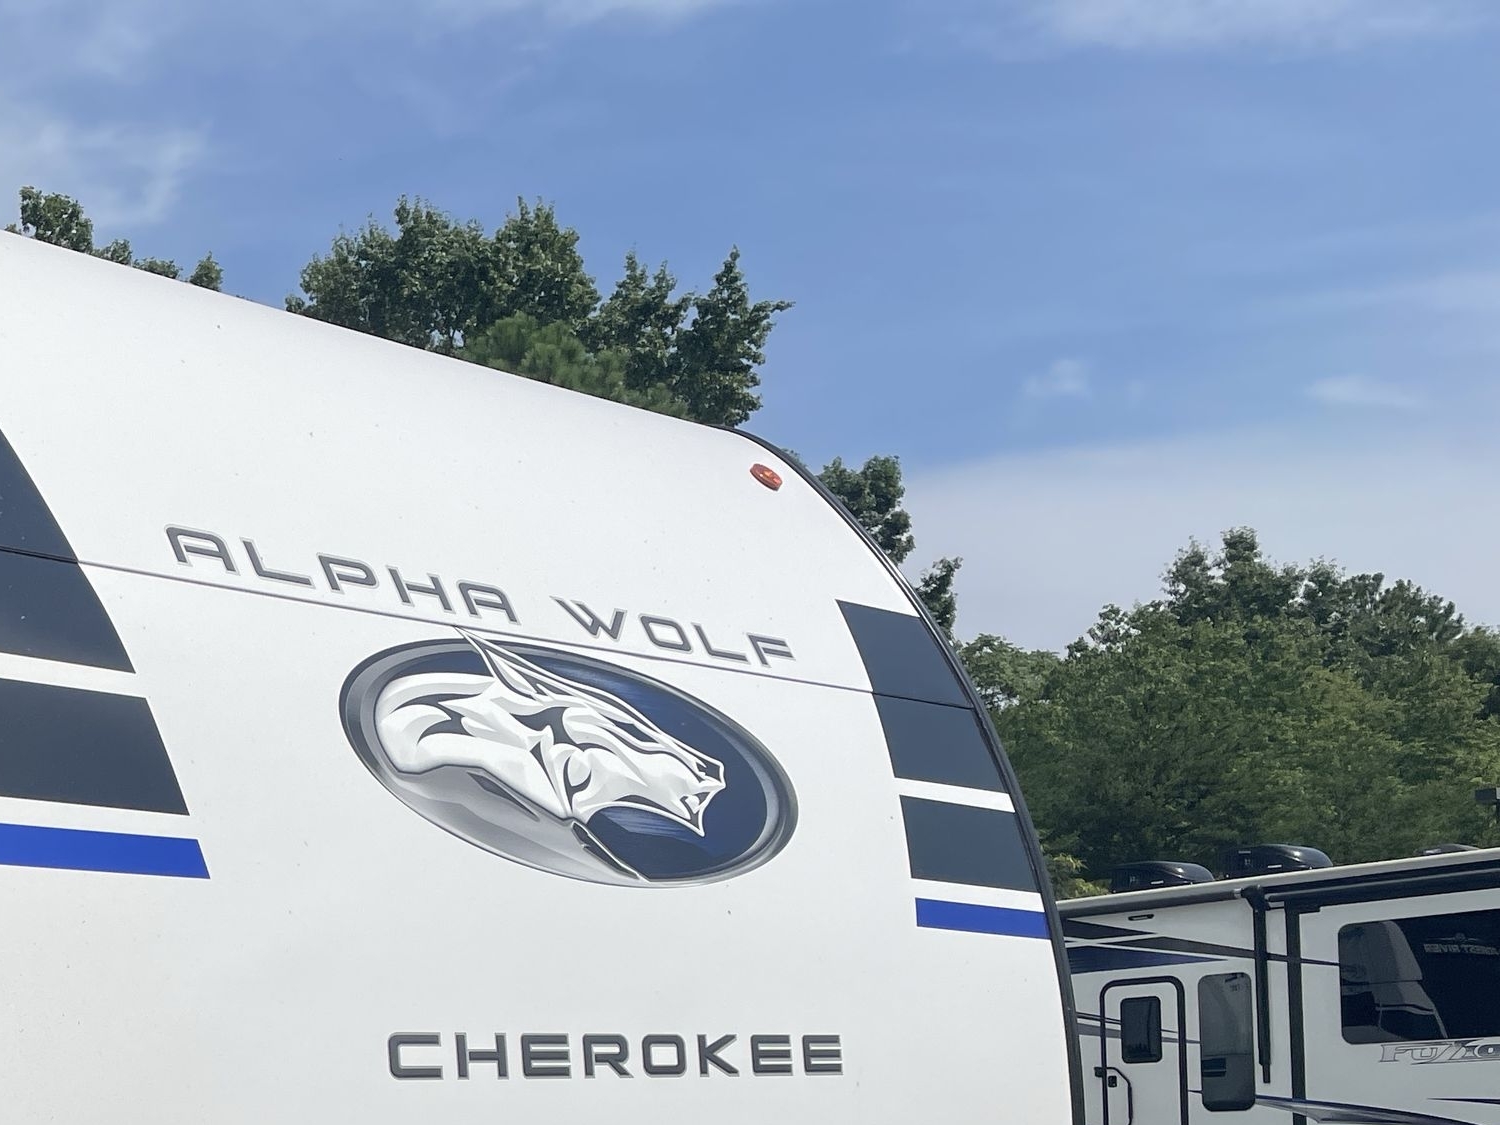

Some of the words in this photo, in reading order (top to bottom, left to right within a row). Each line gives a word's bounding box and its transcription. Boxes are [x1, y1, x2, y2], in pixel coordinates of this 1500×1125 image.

[163, 523, 520, 625] ALPHA
[549, 595, 796, 667] WOLF
[388, 1032, 843, 1080] CHEROKEE
